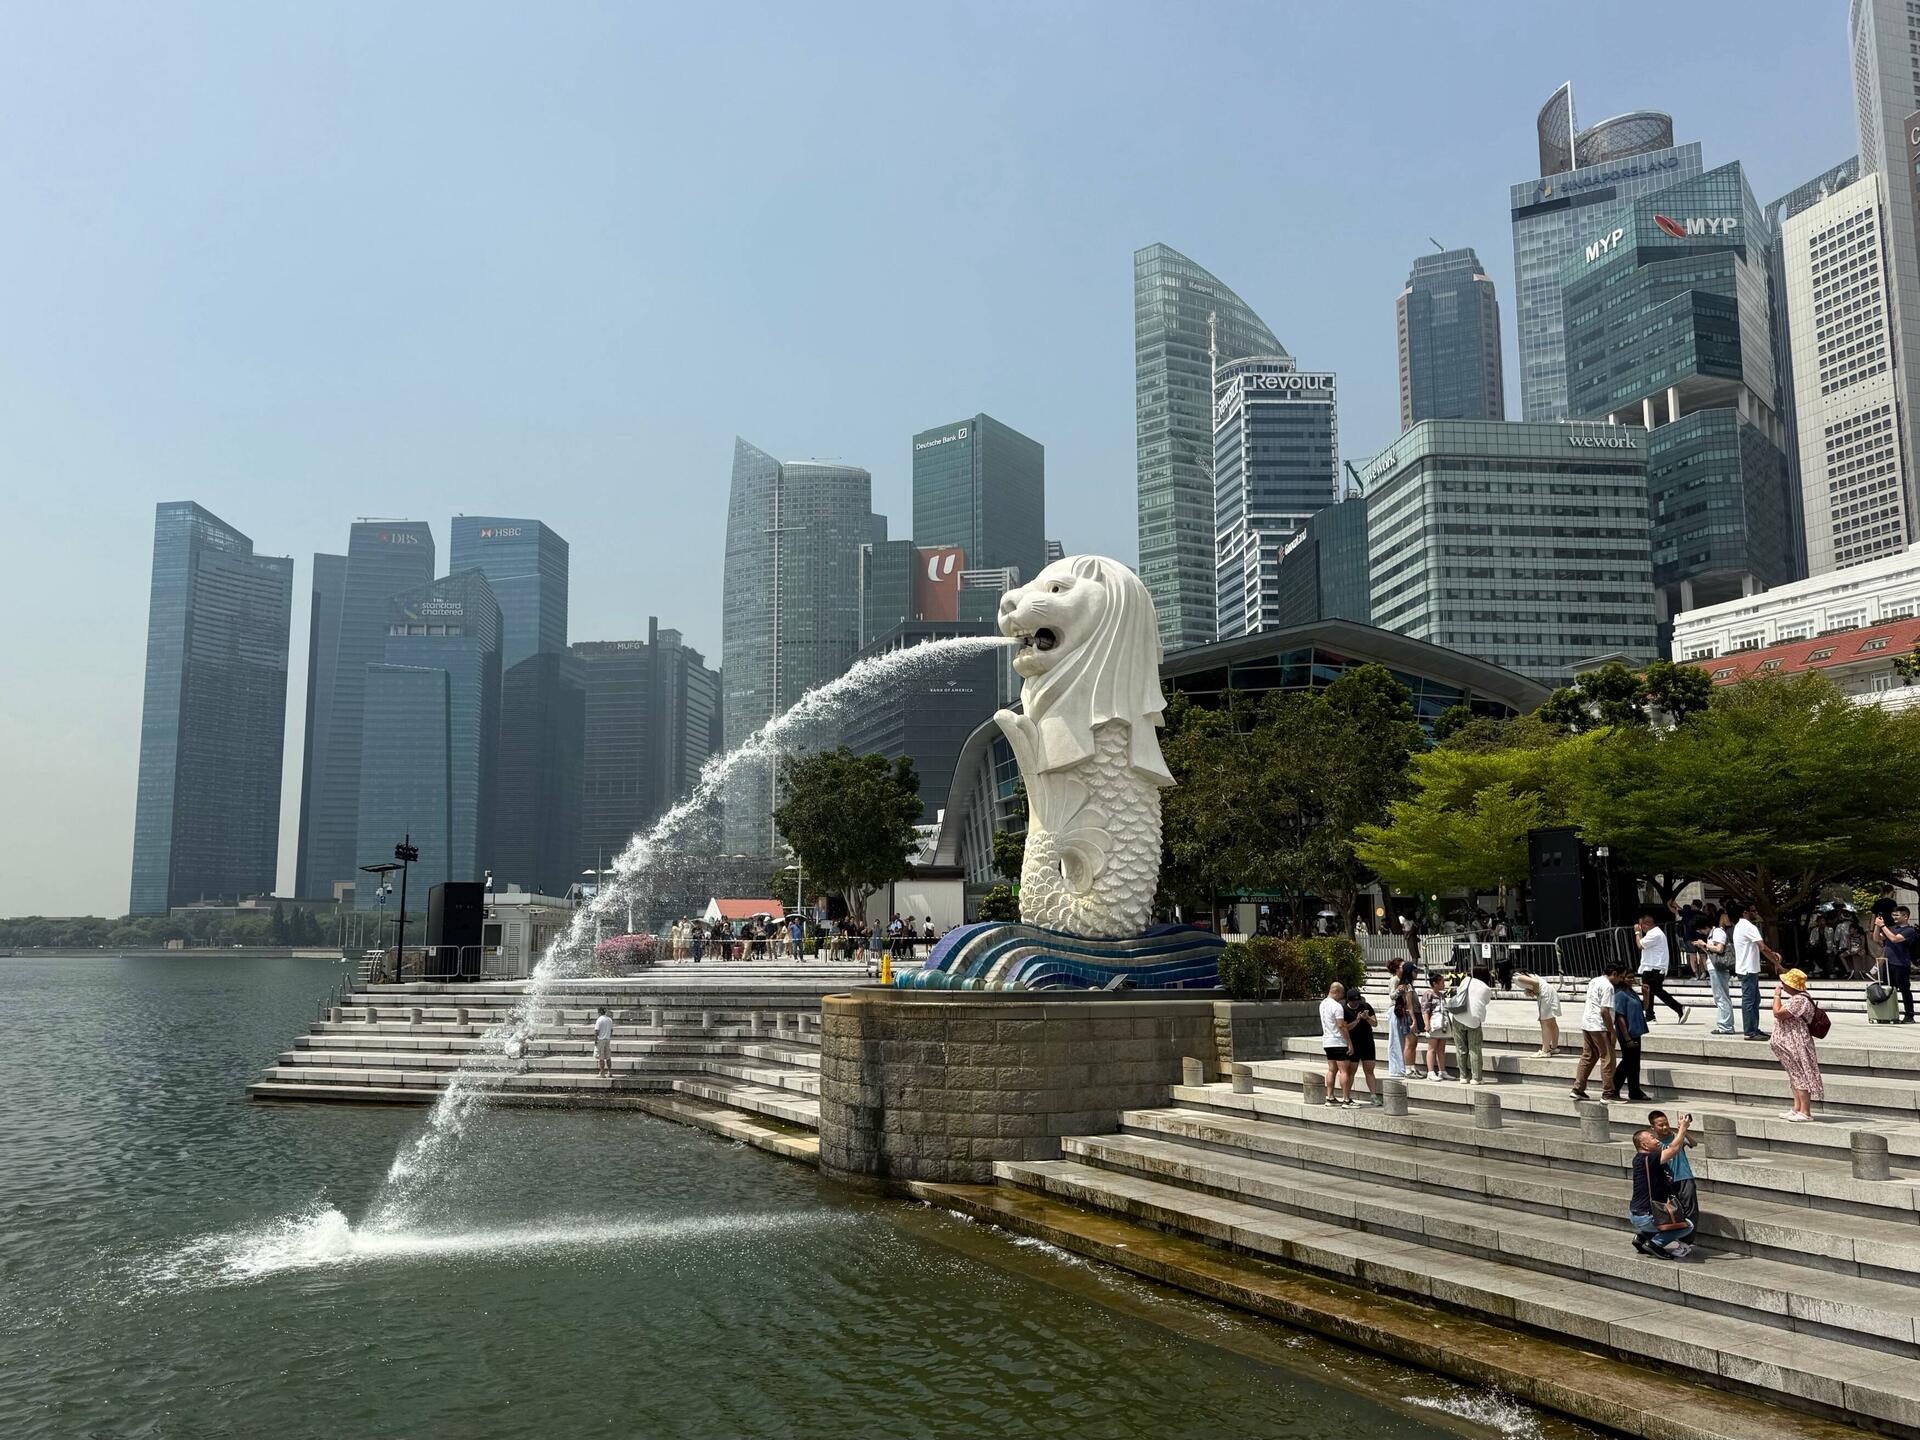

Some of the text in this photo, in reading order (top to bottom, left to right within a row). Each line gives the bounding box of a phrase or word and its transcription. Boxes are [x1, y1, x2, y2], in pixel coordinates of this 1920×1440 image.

[1560, 157, 1679, 192] SINGAPORELAND
[1686, 217, 1737, 235] MYP
[1585, 228, 1623, 263] MYP
[1252, 374, 1327, 390] Revolut
[916, 435, 957, 450] Deutsche Bank
[1568, 433, 1637, 448] wework
[1366, 448, 1396, 483] wework
[391, 533, 418, 544] DBS
[495, 528, 522, 537] HSBC
[421, 608, 464, 616] chartered
[422, 601, 462, 609] standard
[616, 642, 641, 650] MUFG
